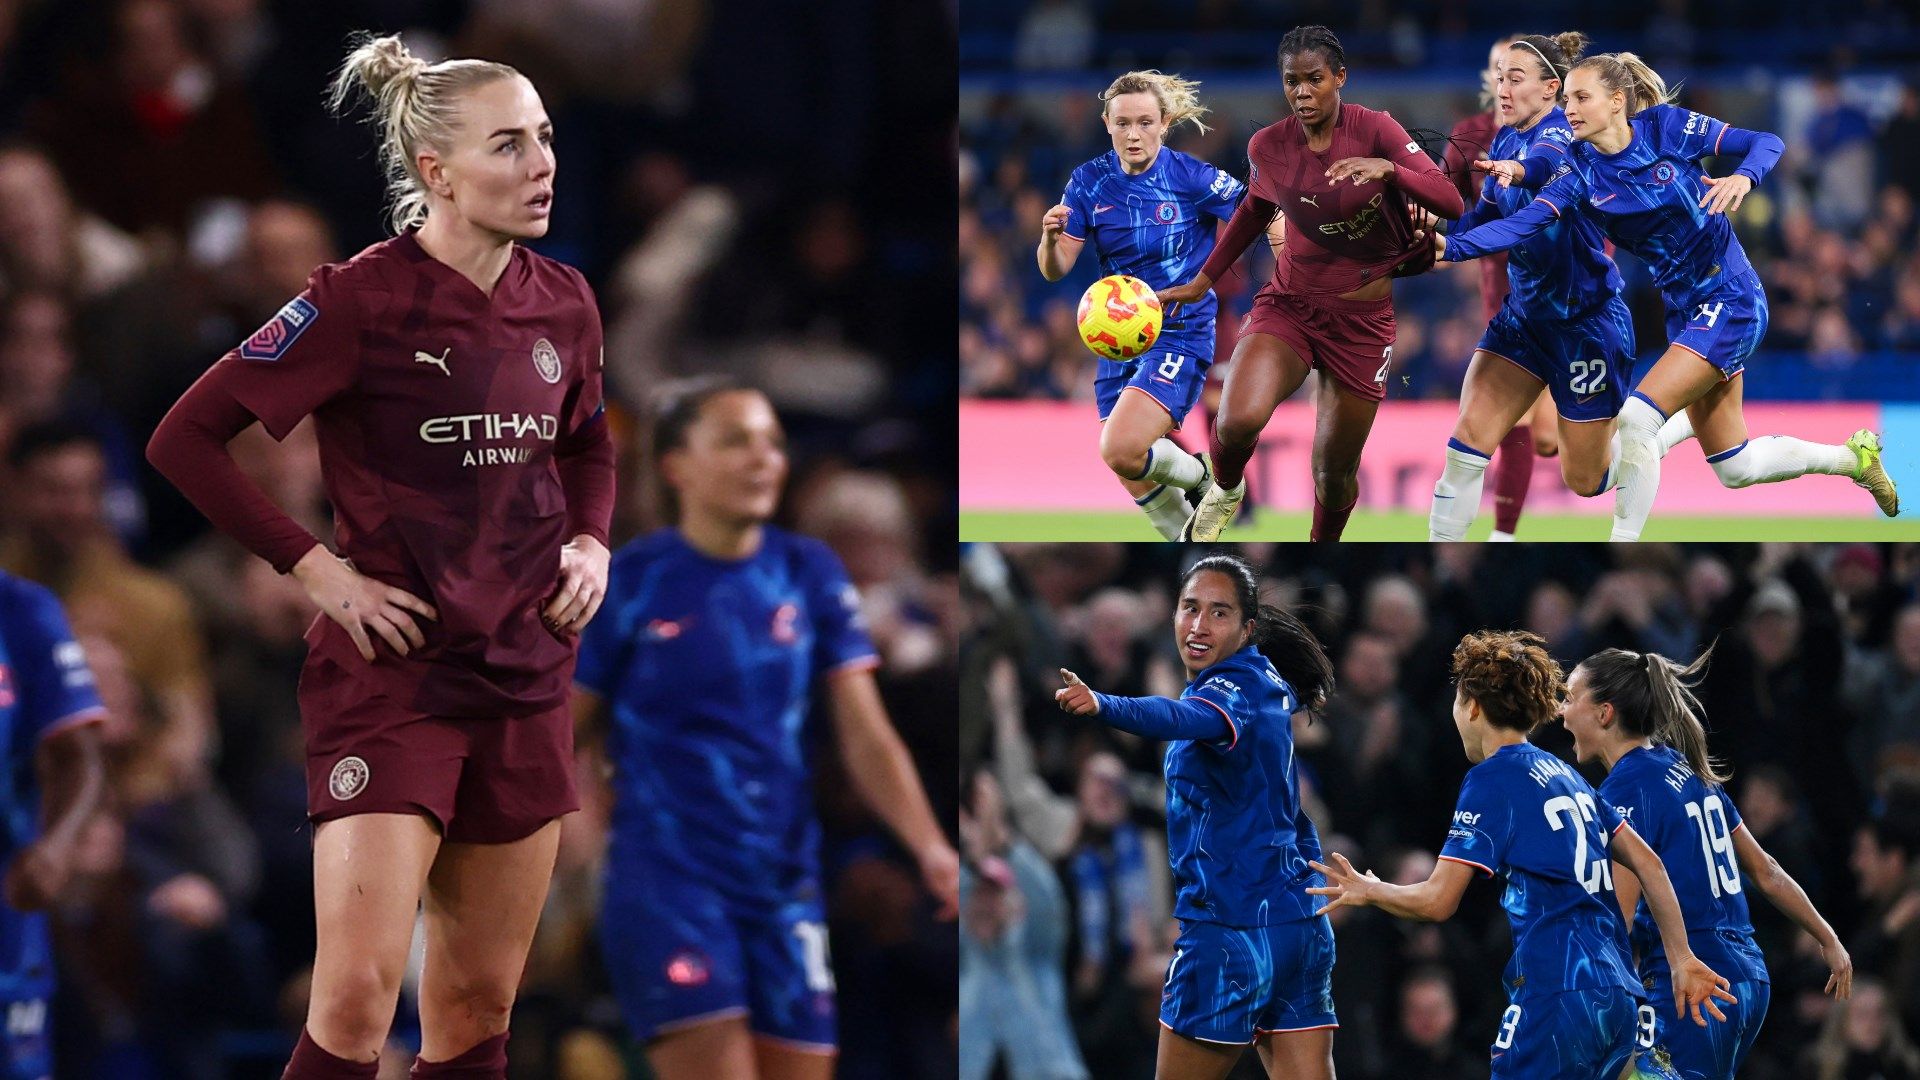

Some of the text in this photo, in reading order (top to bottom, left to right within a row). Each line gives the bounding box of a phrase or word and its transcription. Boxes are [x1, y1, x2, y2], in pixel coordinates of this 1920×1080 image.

[1319, 193, 1383, 235] ETIHAD
[1158, 352, 1184, 380] 8
[1374, 345, 1393, 383] 2
[1570, 359, 1606, 394] 22
[419, 413, 558, 443] ETIHAD
[462, 447, 532, 467] AIRWAY
[1685, 795, 1741, 899] 19
